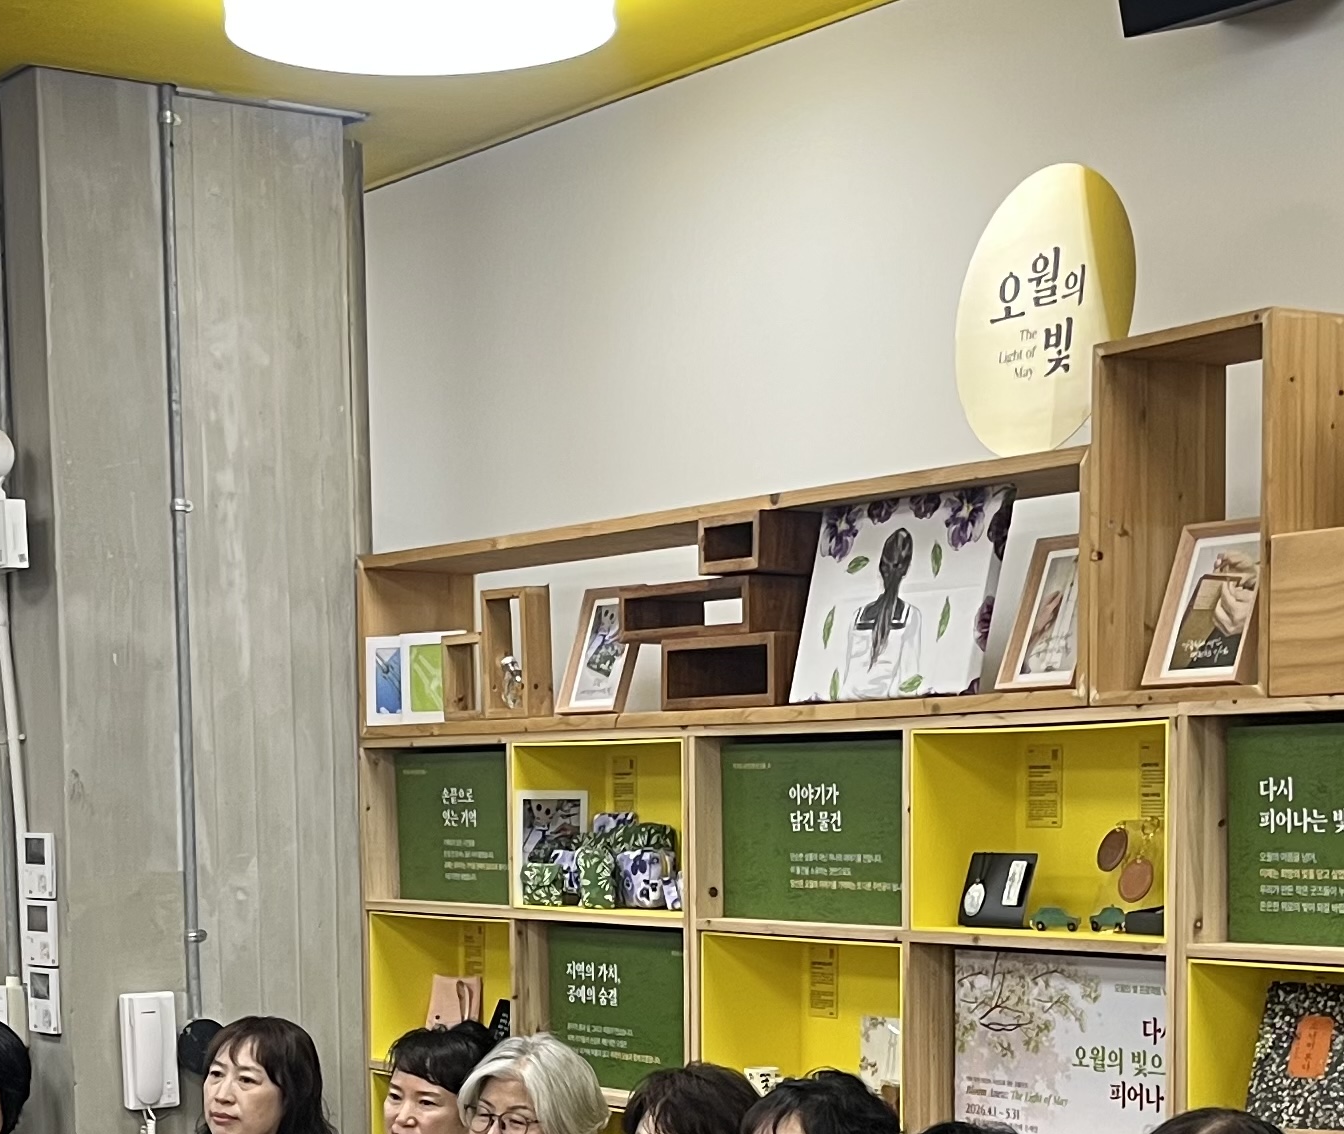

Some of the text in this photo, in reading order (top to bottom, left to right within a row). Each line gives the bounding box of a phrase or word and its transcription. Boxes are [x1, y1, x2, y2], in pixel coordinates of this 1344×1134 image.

[990, 246, 1087, 325] 오월의
[1019, 328, 1038, 342] The
[998, 344, 1038, 366] Light of
[1043, 316, 1074, 378] 빛
[1012, 365, 1035, 381] May
[442, 787, 474, 805] 손끝으로
[788, 783, 840, 806] 이야기가
[1258, 776, 1293, 803] 다시
[461, 809, 477, 828] 기억
[789, 810, 842, 832] 담긴 물건
[1258, 807, 1329, 834] 피어나는
[566, 960, 621, 985] 지역의 가치,
[566, 984, 618, 1007] 공예의 숨결
[1071, 1046, 1123, 1076] 오월의
[1109, 1080, 1165, 1113] 피어나
